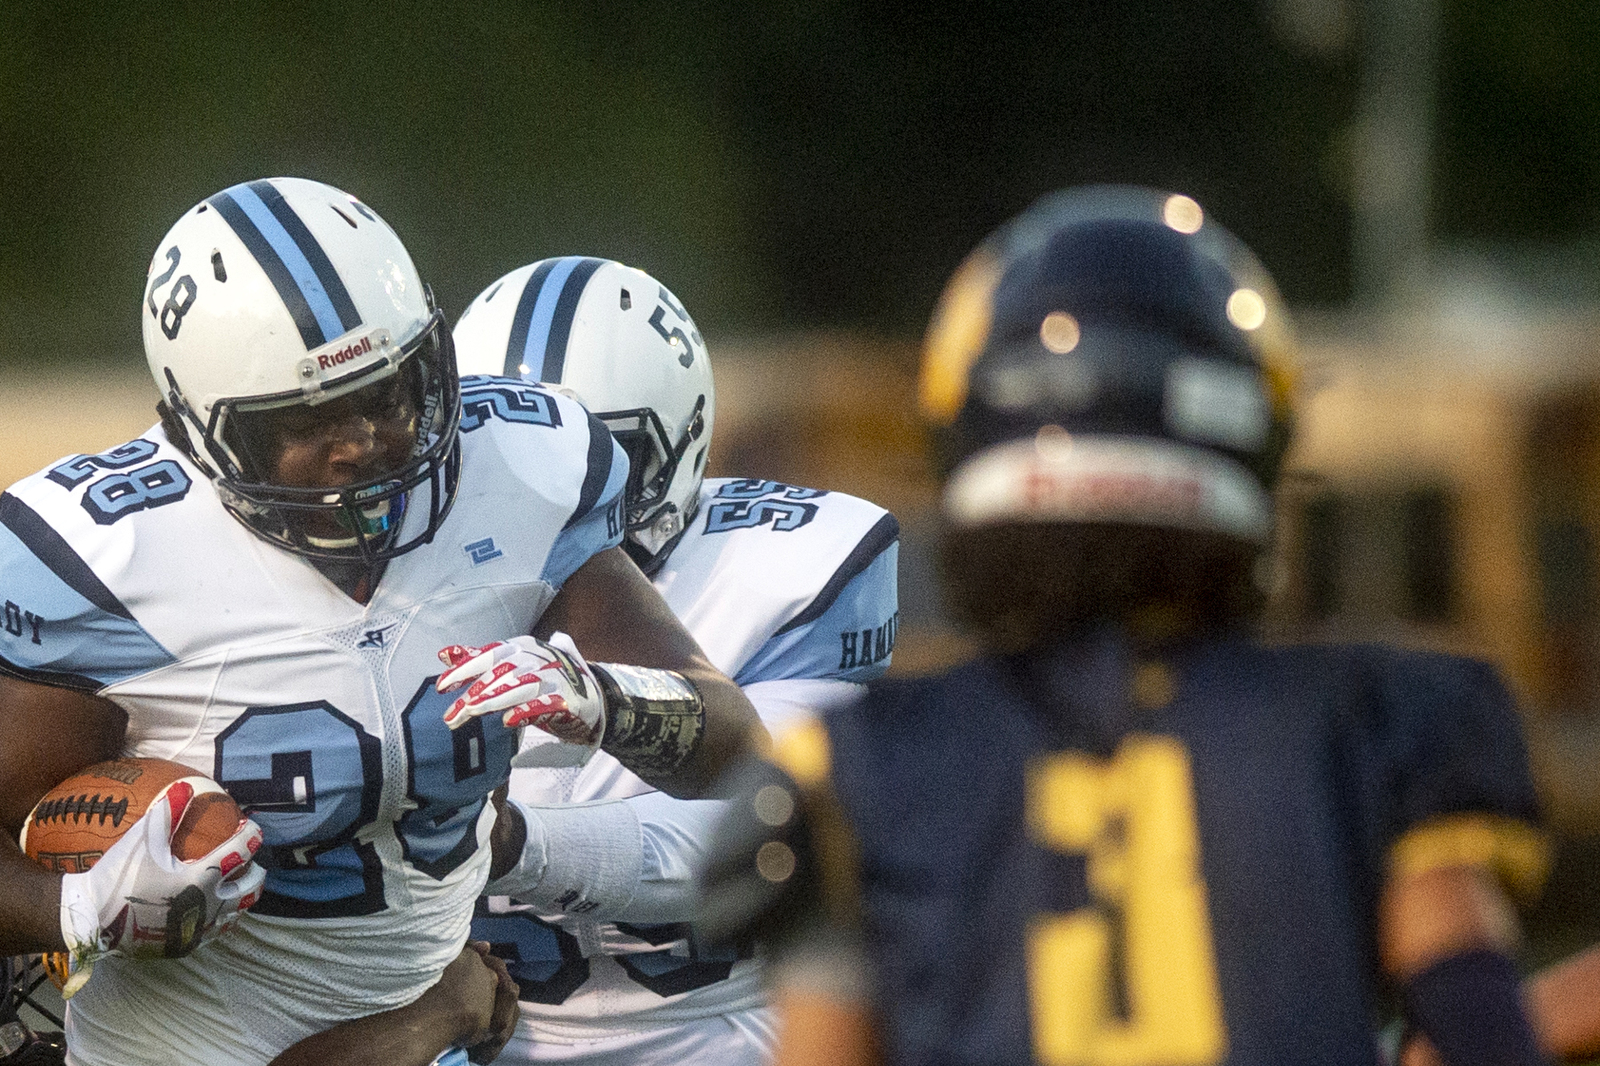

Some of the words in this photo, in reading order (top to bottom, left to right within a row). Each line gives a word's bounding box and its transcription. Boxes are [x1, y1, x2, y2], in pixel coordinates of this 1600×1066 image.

[148, 245, 197, 340] 28
[317, 337, 372, 371] Riddell
[45, 438, 193, 527] 28
[213, 675, 520, 919] 28
